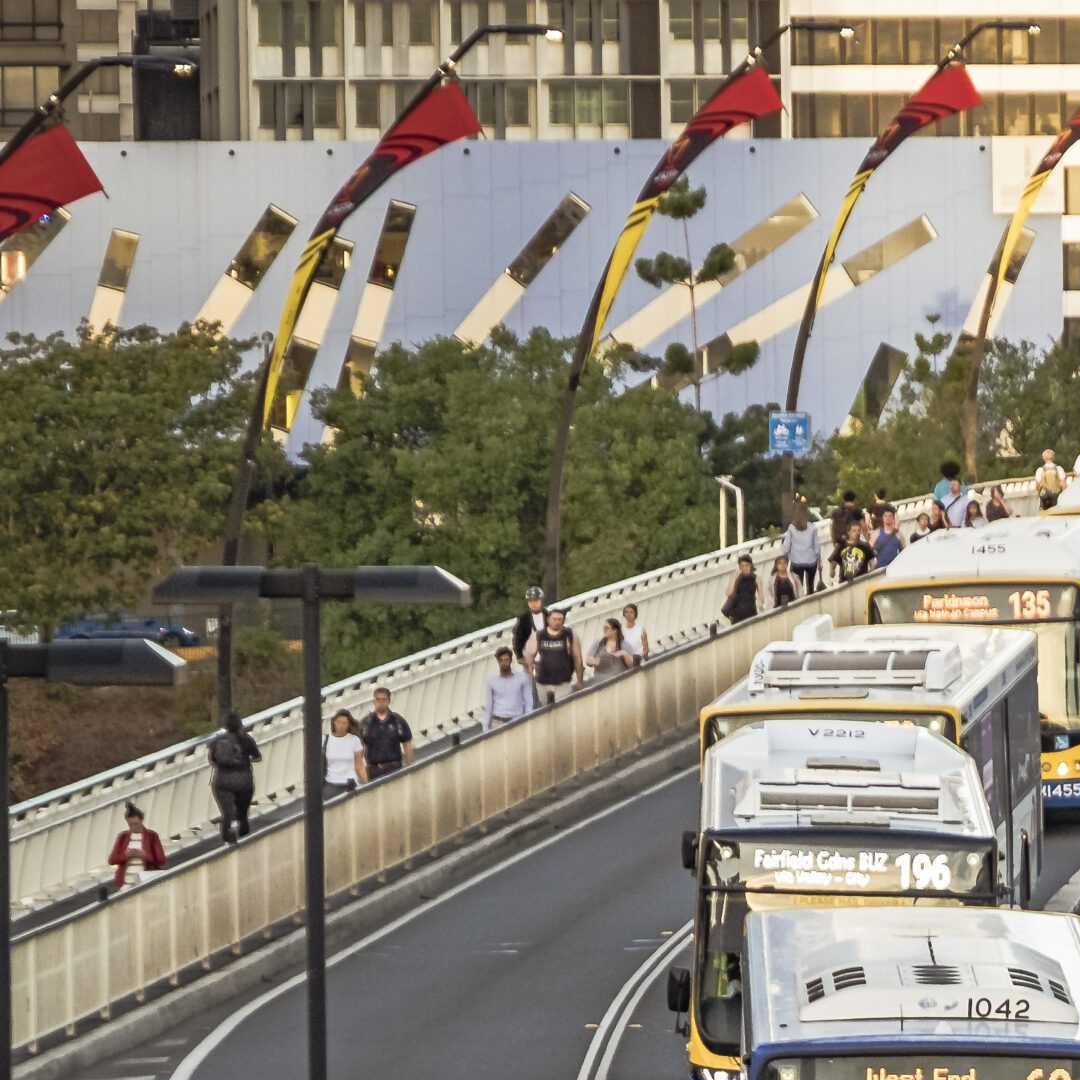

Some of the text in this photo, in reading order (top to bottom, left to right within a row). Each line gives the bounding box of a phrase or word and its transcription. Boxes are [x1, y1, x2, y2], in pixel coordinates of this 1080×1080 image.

[972, 544, 1006, 554] 1455
[923, 589, 1051, 619] Parkinson 135
[859, 852, 889, 872] BUZ
[895, 853, 951, 890] 196
[968, 998, 1030, 1019] 1042
